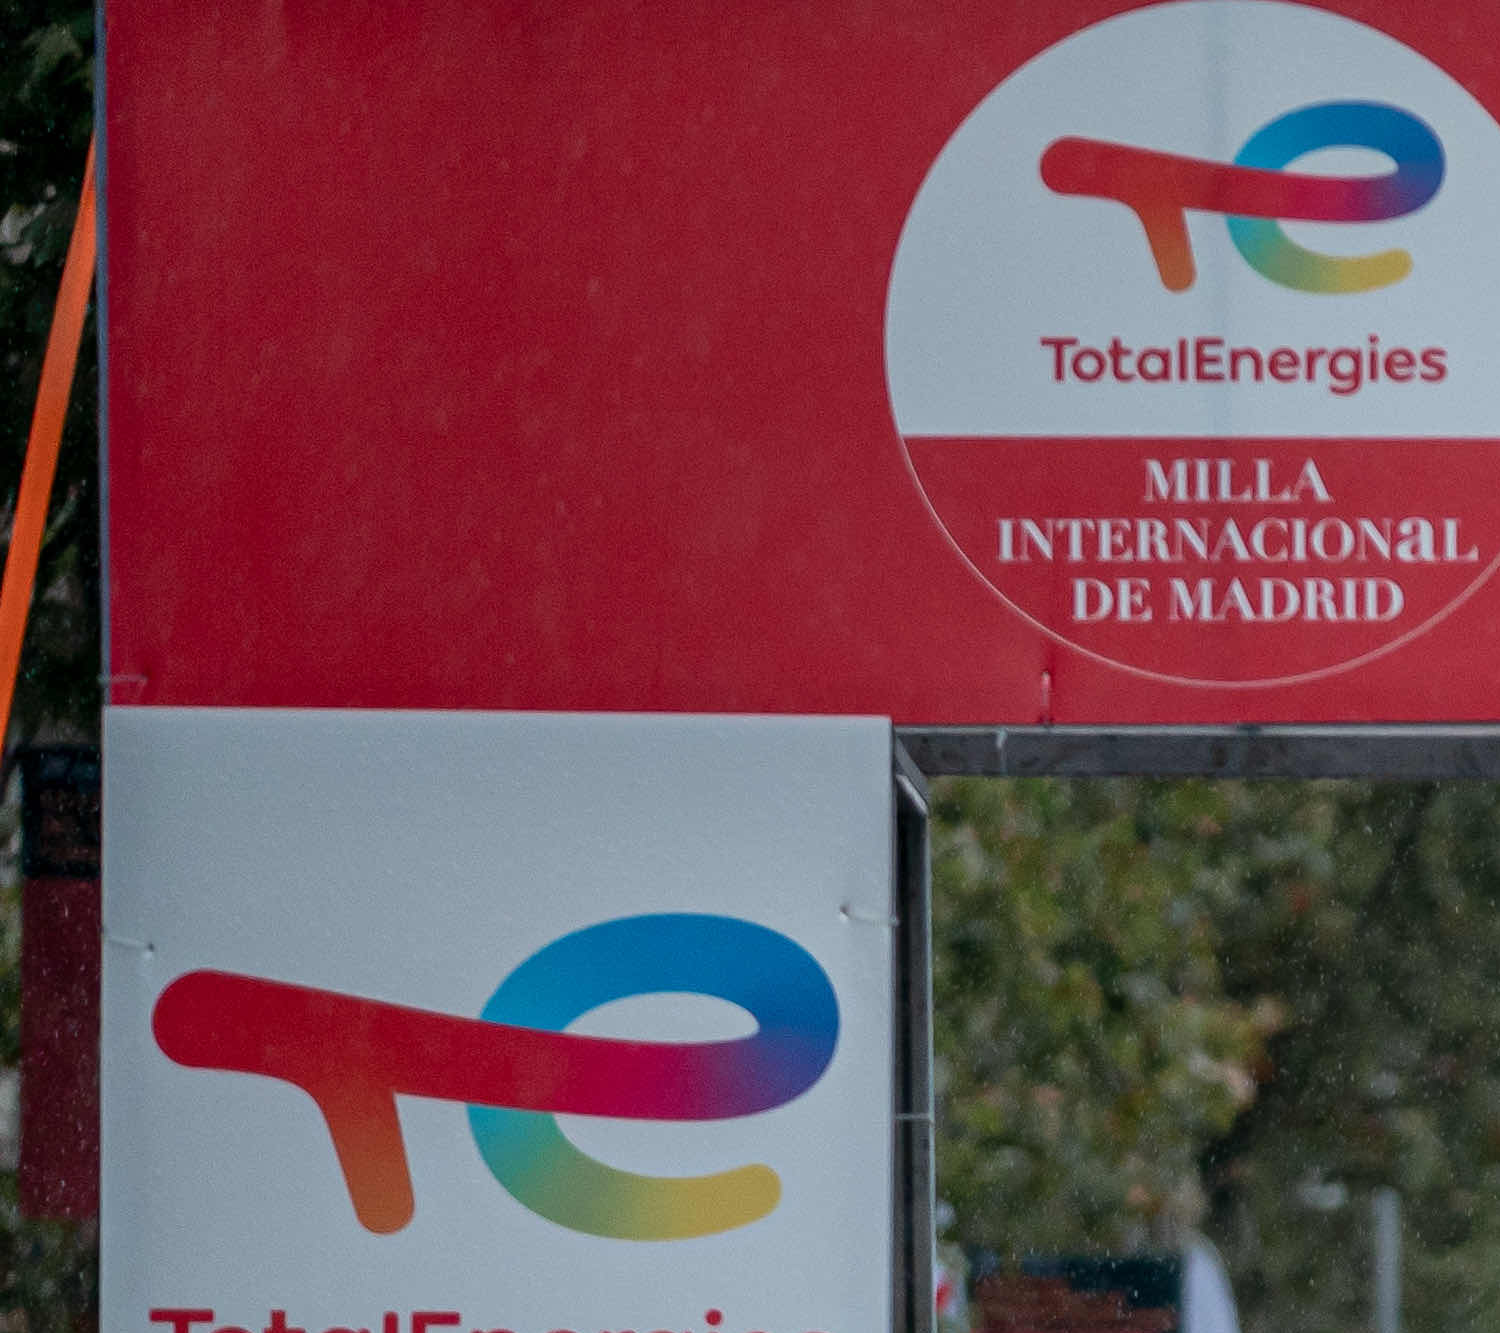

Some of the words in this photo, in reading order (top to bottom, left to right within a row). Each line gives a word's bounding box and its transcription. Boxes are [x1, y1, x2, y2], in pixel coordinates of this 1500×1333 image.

[1040, 335, 1447, 395] TotalEnergies
[1144, 458, 1334, 503] MILLA
[1071, 577, 1152, 622] DE
[1169, 577, 1405, 622] MADRID
